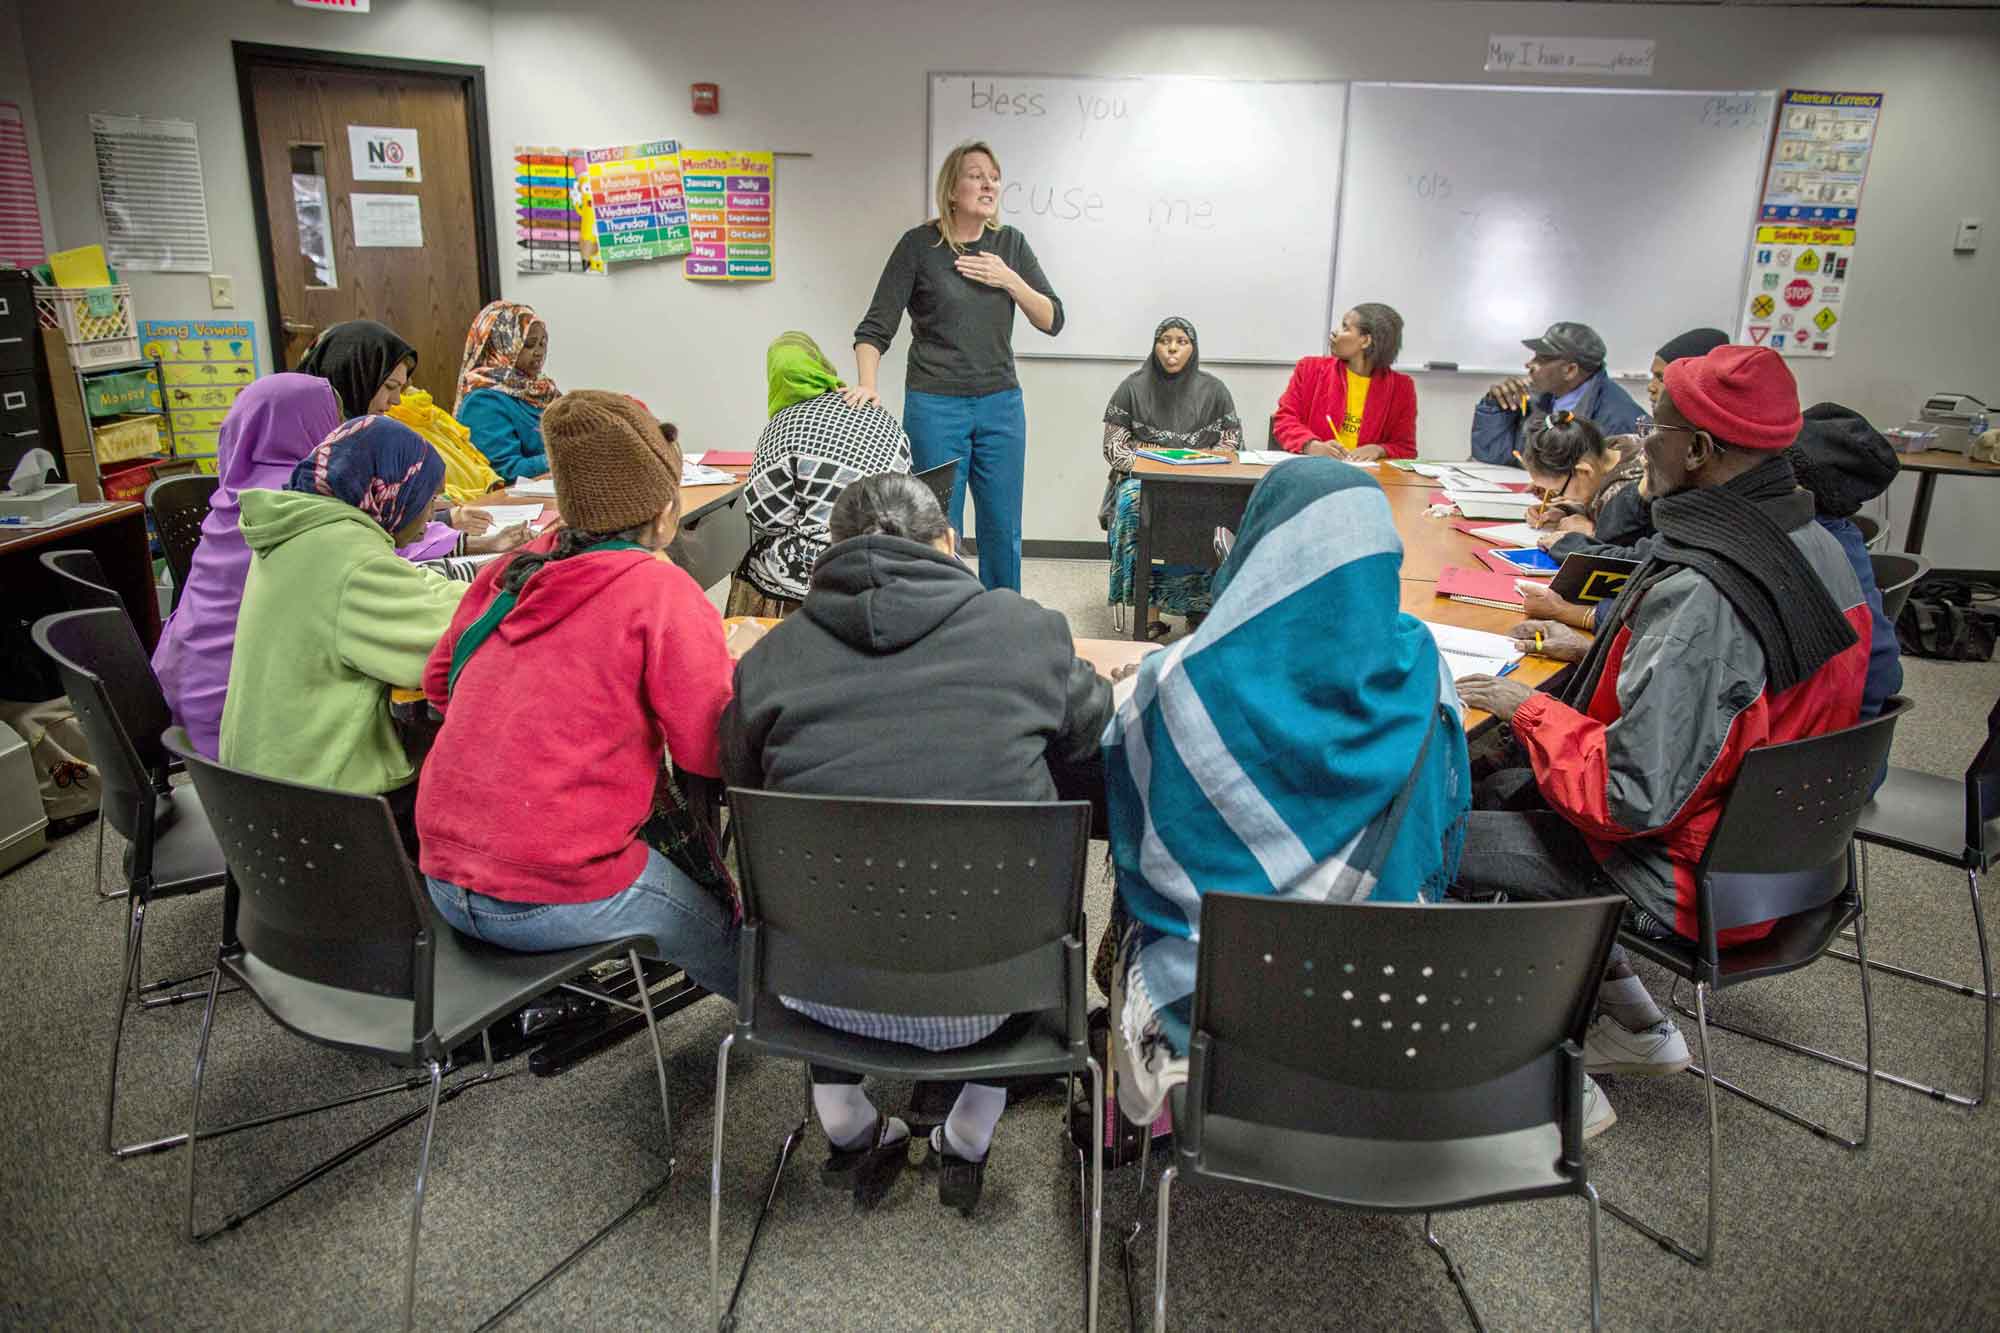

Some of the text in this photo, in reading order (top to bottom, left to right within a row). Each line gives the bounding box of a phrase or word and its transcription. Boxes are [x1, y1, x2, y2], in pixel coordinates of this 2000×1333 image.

[1520, 41, 1536, 64] I
[1792, 92, 1880, 107] American Currency
[971, 80, 1129, 141] bless you
[683, 158, 727, 171] Months
[739, 158, 769, 174] Year
[686, 177, 722, 189] January
[737, 179, 760, 191] July
[732, 196, 766, 208] August
[598, 201, 652, 218] Wednesday
[1149, 197, 1218, 232] me
[606, 215, 649, 231] Thursday
[690, 212, 720, 222] March
[728, 213, 769, 224] September
[614, 230, 644, 245] Friday
[693, 229, 717, 240] April
[730, 230, 768, 240] October
[1774, 230, 1841, 243] Safety Signs
[608, 243, 653, 259] Saturday
[695, 245, 716, 257] May
[730, 246, 769, 257] November
[693, 262, 719, 273] June
[729, 263, 769, 274] December
[1785, 288, 1814, 300] STOP
[146, 321, 250, 339] Long Vowels
